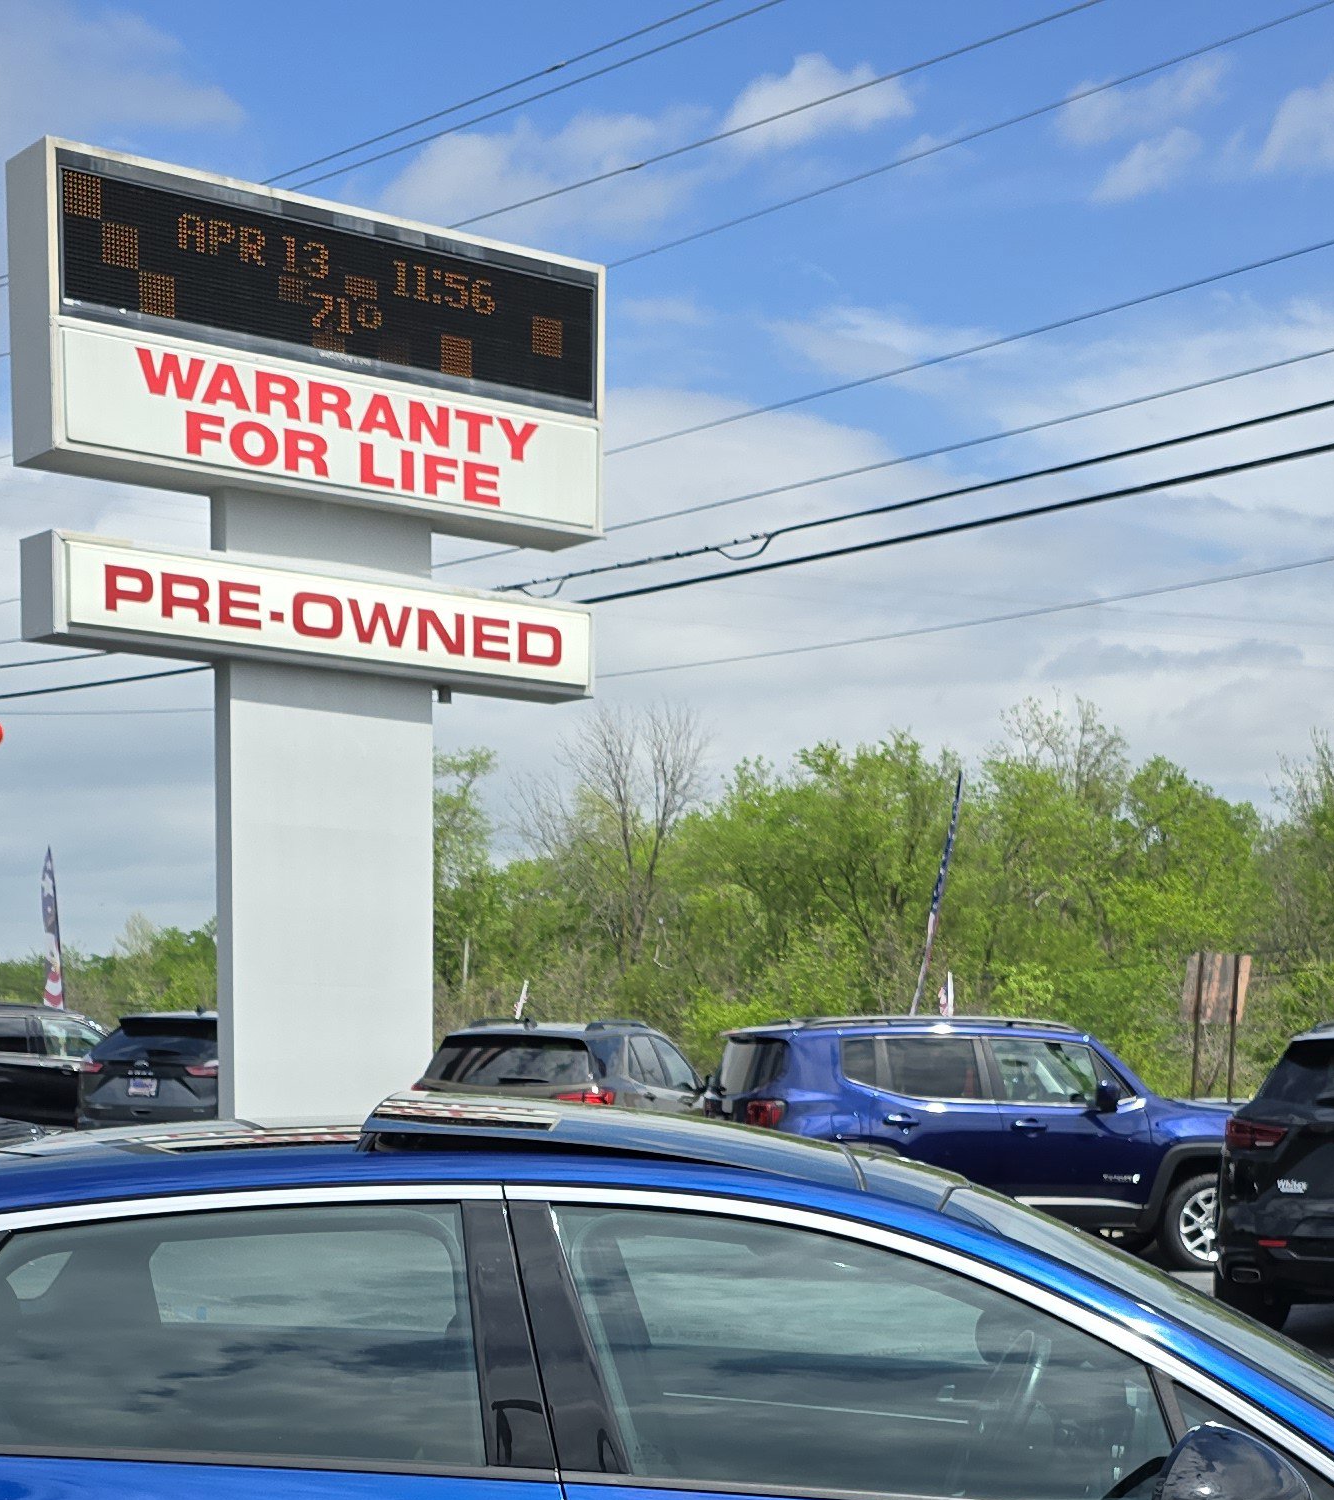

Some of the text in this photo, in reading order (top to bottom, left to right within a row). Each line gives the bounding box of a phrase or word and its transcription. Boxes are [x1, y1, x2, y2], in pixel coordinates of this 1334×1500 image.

[178, 212, 496, 316] APR 13 11:56
[136, 347, 539, 461] WARRANTY
[185, 410, 501, 507] FOR LIFE
[104, 563, 562, 667] PRE-OWNED
